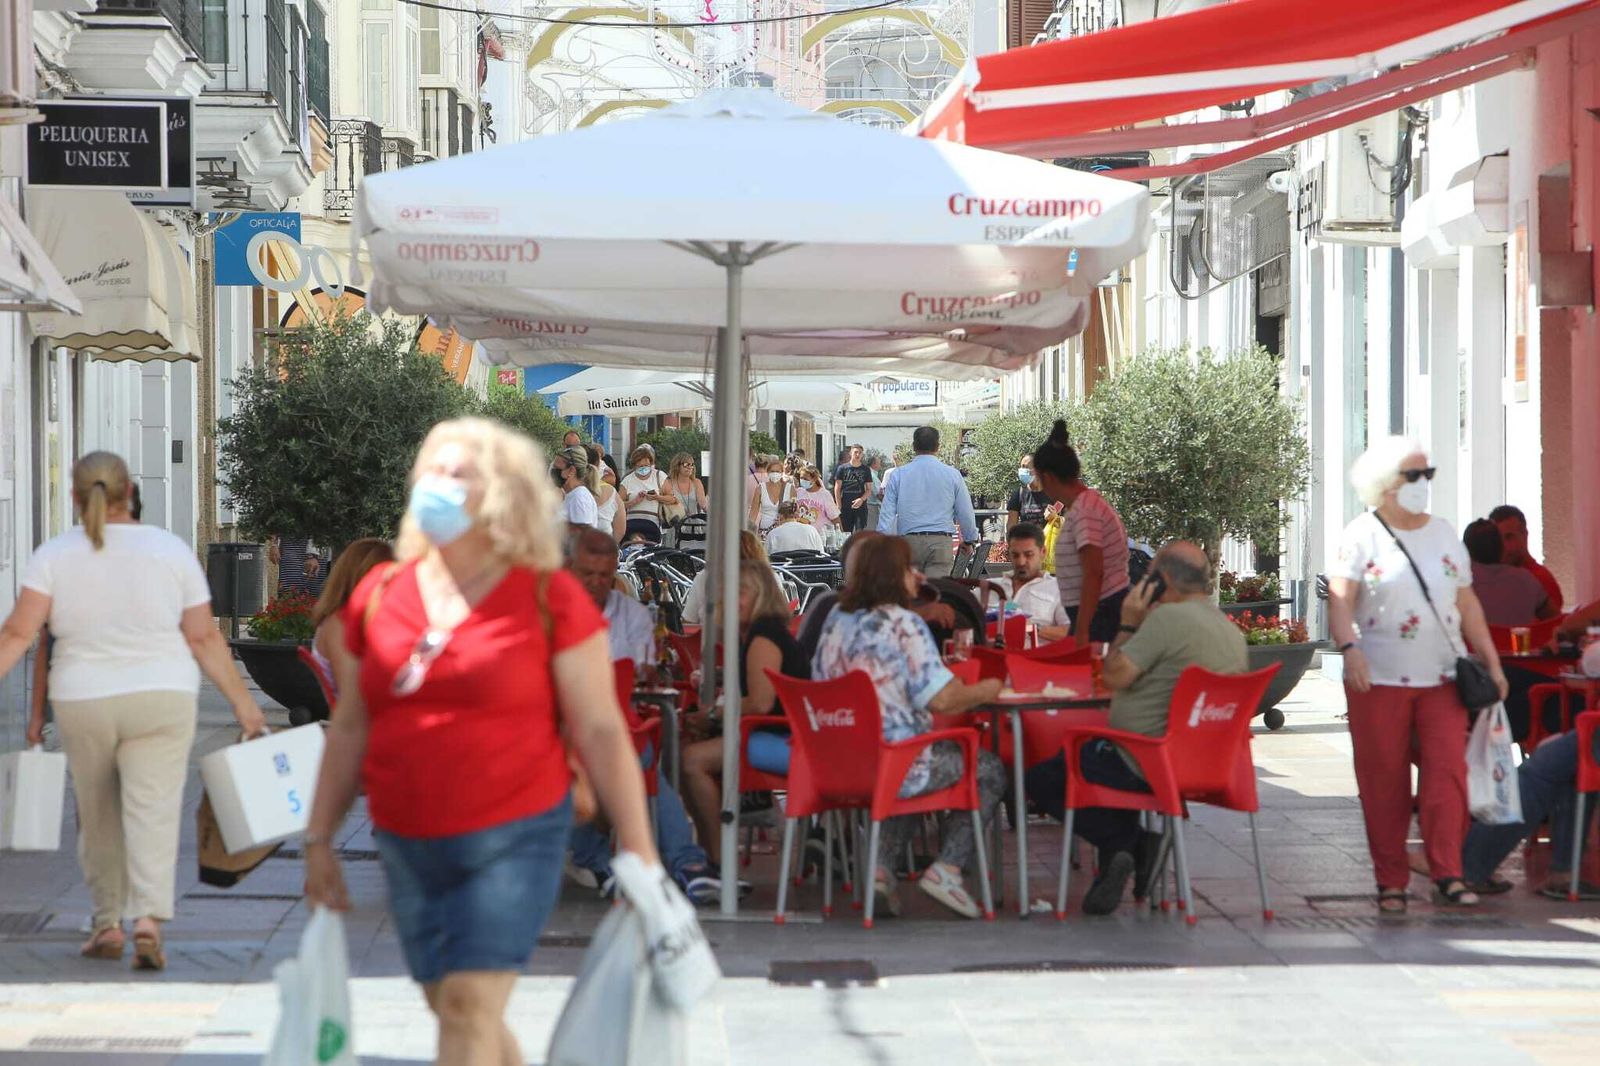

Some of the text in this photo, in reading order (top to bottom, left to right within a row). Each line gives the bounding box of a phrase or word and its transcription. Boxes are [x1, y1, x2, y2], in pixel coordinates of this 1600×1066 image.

[39, 125, 149, 145] PELUQUERIA
[64, 150, 131, 168] UNISEX
[948, 192, 1102, 220] Cruzcampo
[882, 379, 930, 393] populares
[603, 397, 638, 409] Galicia
